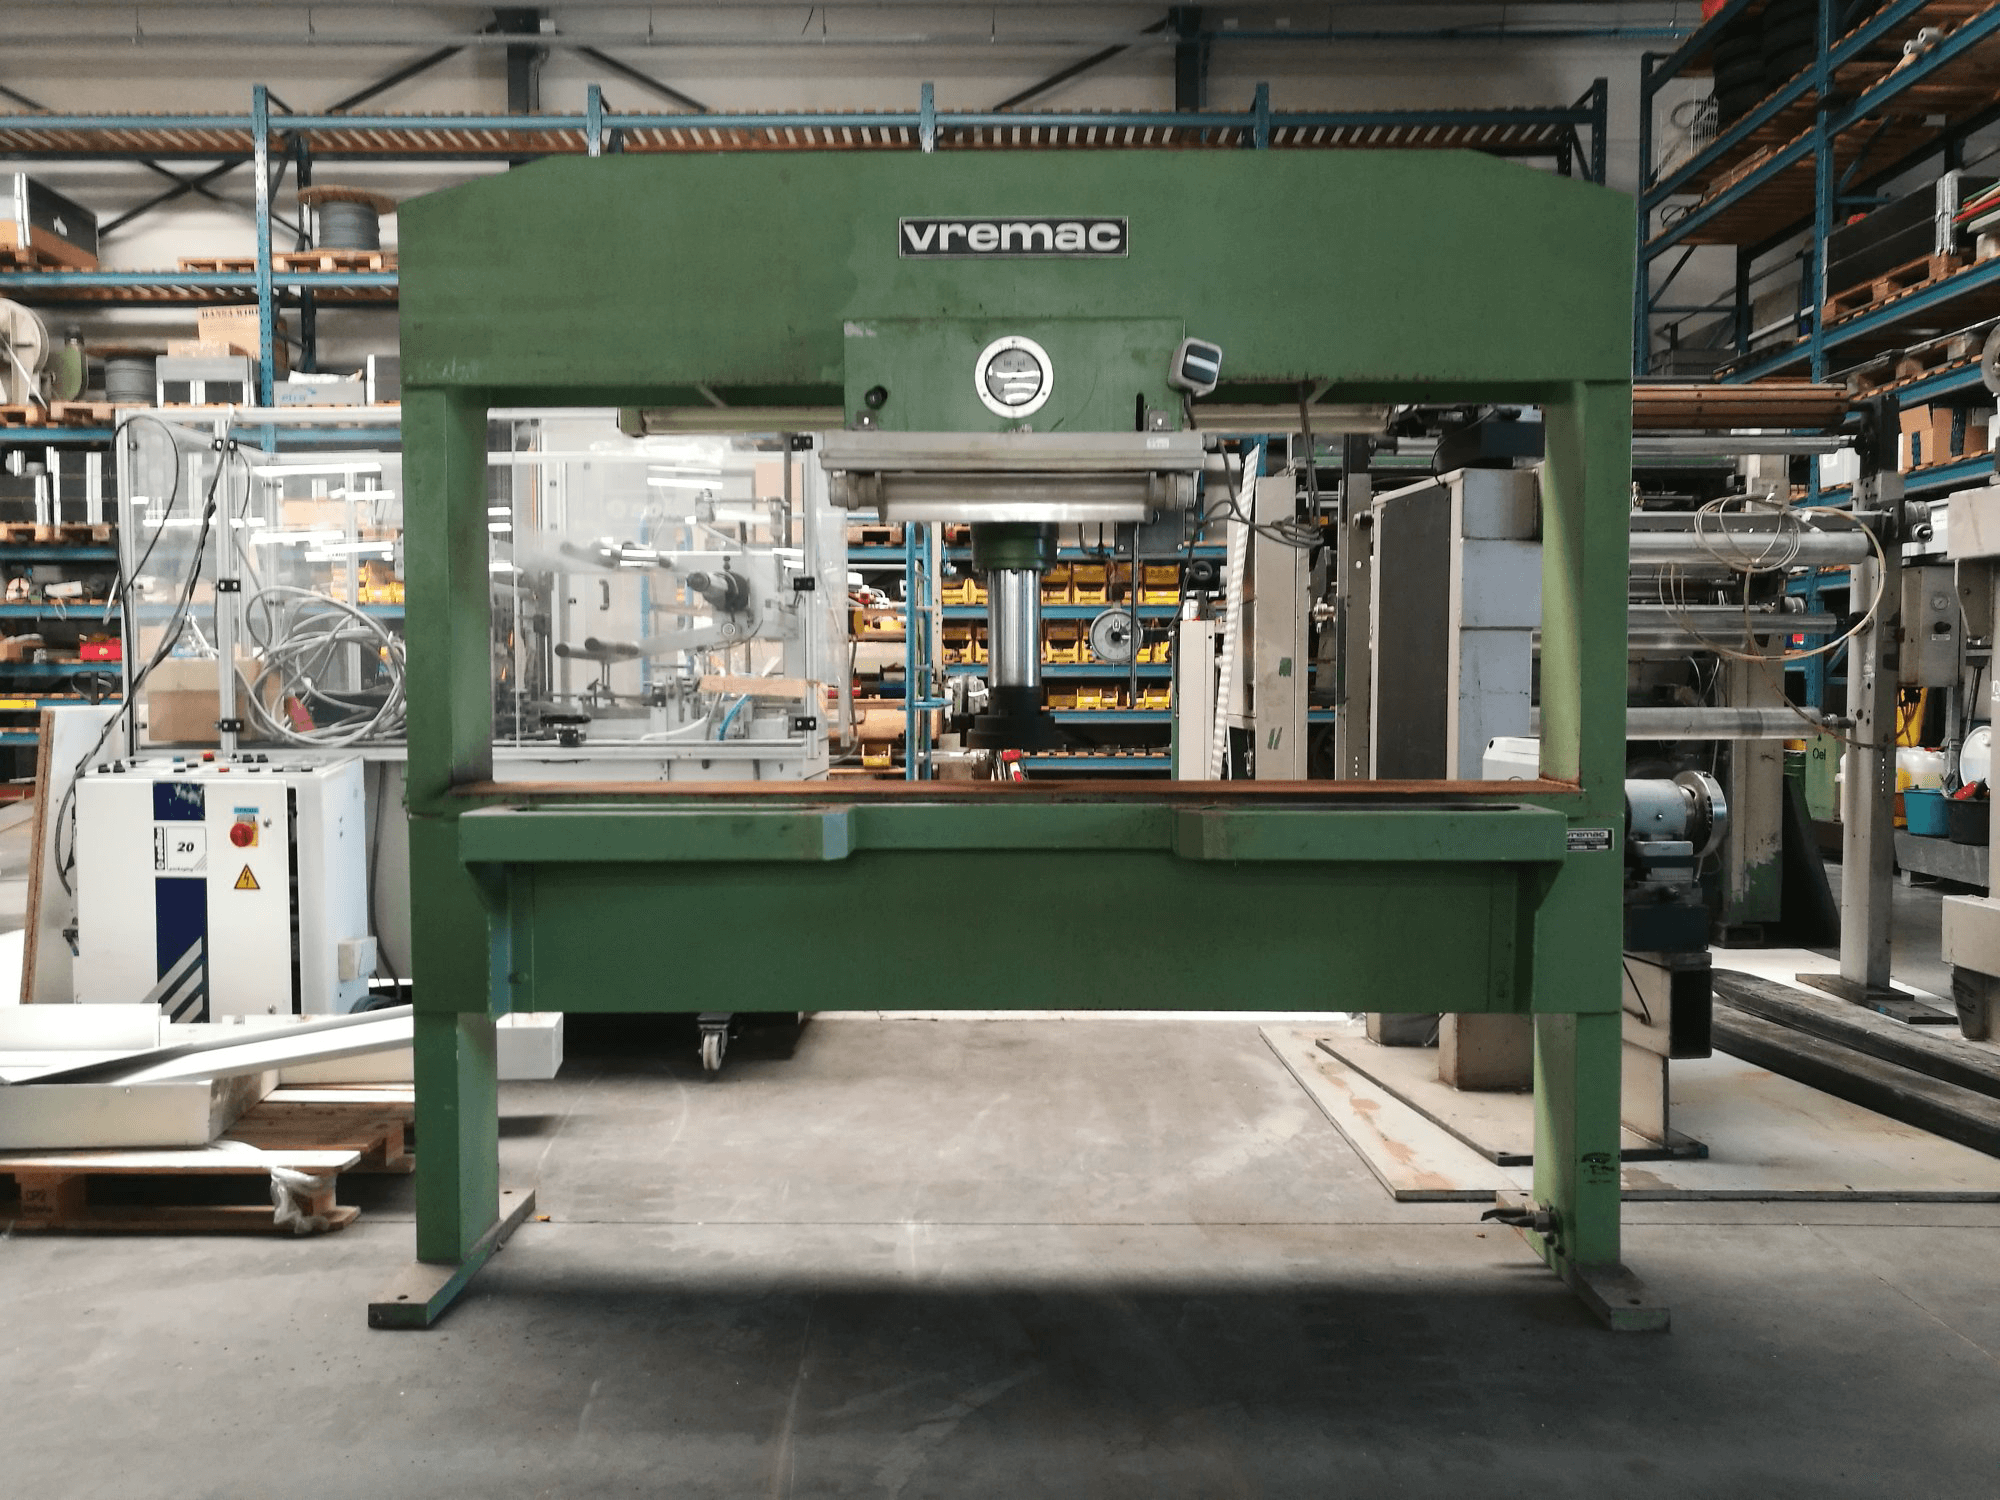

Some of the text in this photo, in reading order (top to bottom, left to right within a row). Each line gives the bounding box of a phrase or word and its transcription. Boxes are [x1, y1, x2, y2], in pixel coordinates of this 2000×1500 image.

[903, 222, 1121, 251] vremac
[1812, 747, 1827, 760] Oel
[177, 841, 195, 853] 20
